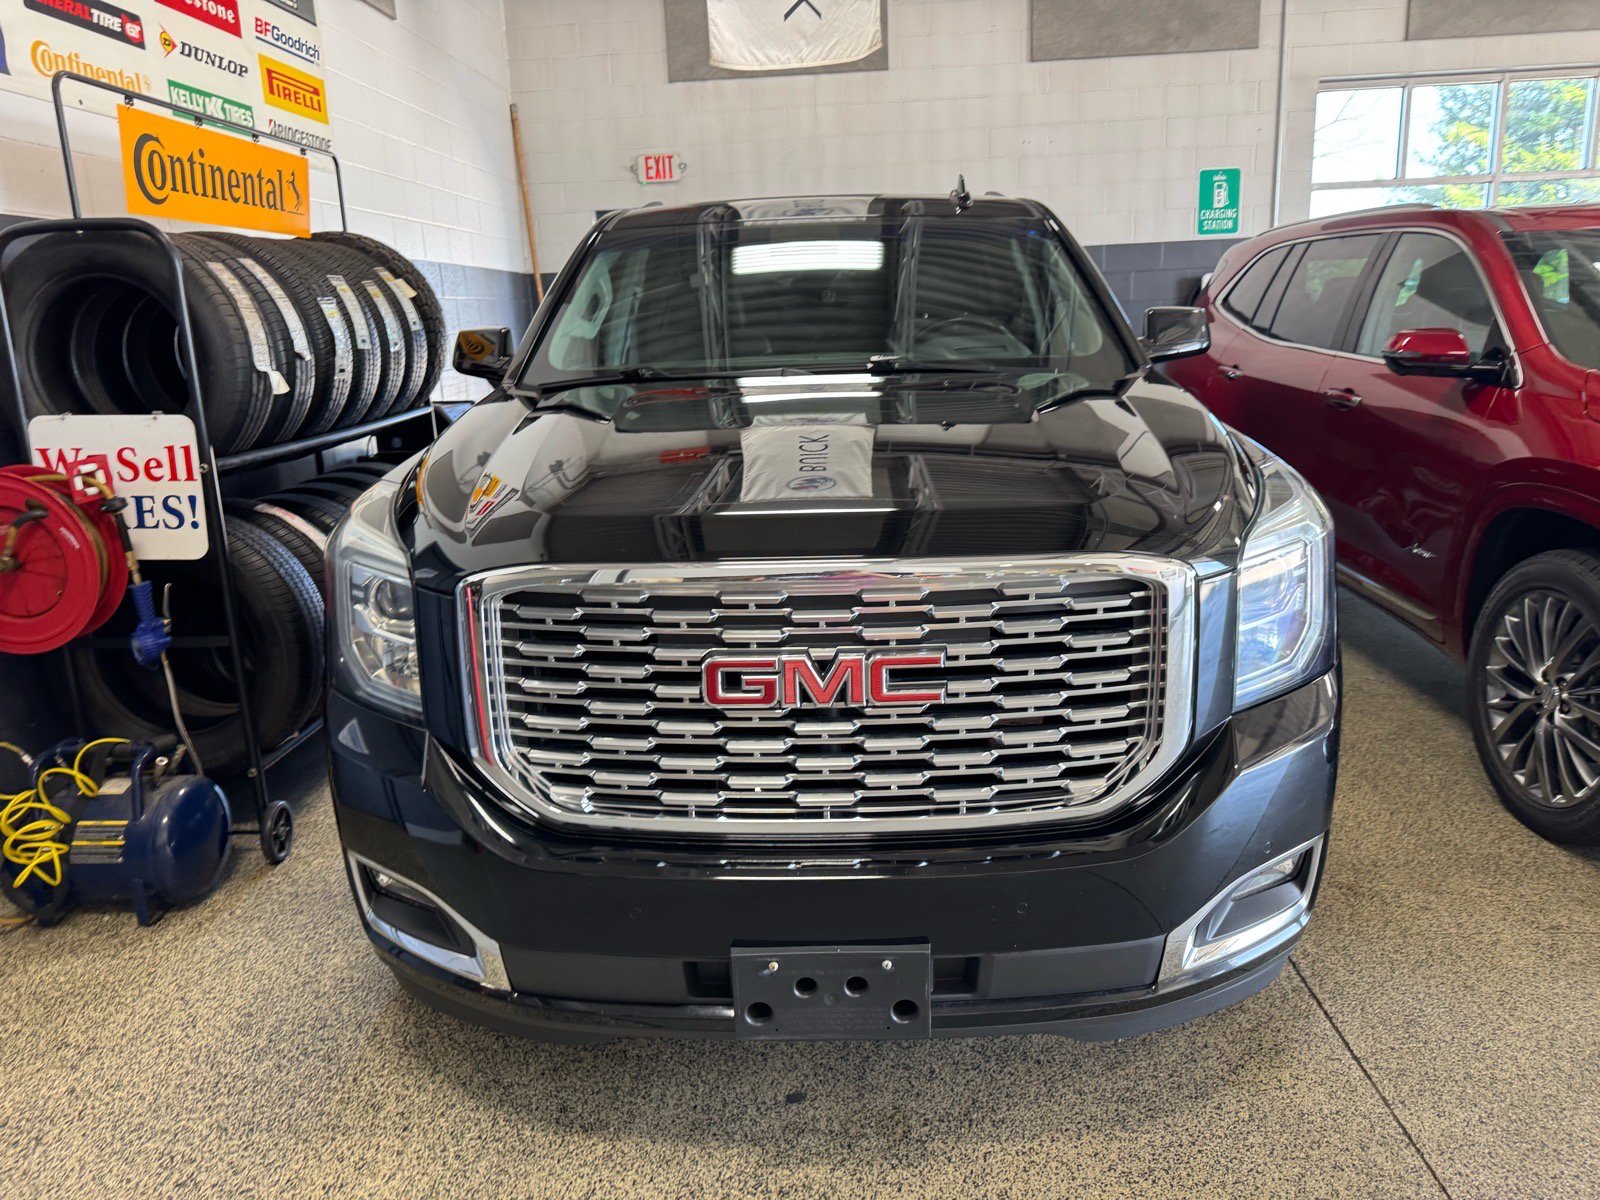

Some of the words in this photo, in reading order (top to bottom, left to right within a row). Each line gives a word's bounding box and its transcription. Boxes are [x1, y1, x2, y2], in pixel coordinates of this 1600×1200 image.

[91, 8, 122, 32] TIRE
[255, 16, 320, 61] BFGoodrich
[180, 41, 249, 78] DUNLOP
[169, 86, 205, 114] KELLY
[223, 103, 254, 127] TIRES
[265, 67, 322, 113] PIRELLI
[133, 133, 286, 212] Continental
[644, 154, 674, 180] EXIT
[1200, 208, 1237, 220] CHARGING
[1202, 219, 1234, 231] STATION
[116, 445, 199, 482] Sell
[702, 648, 946, 708] GMC
